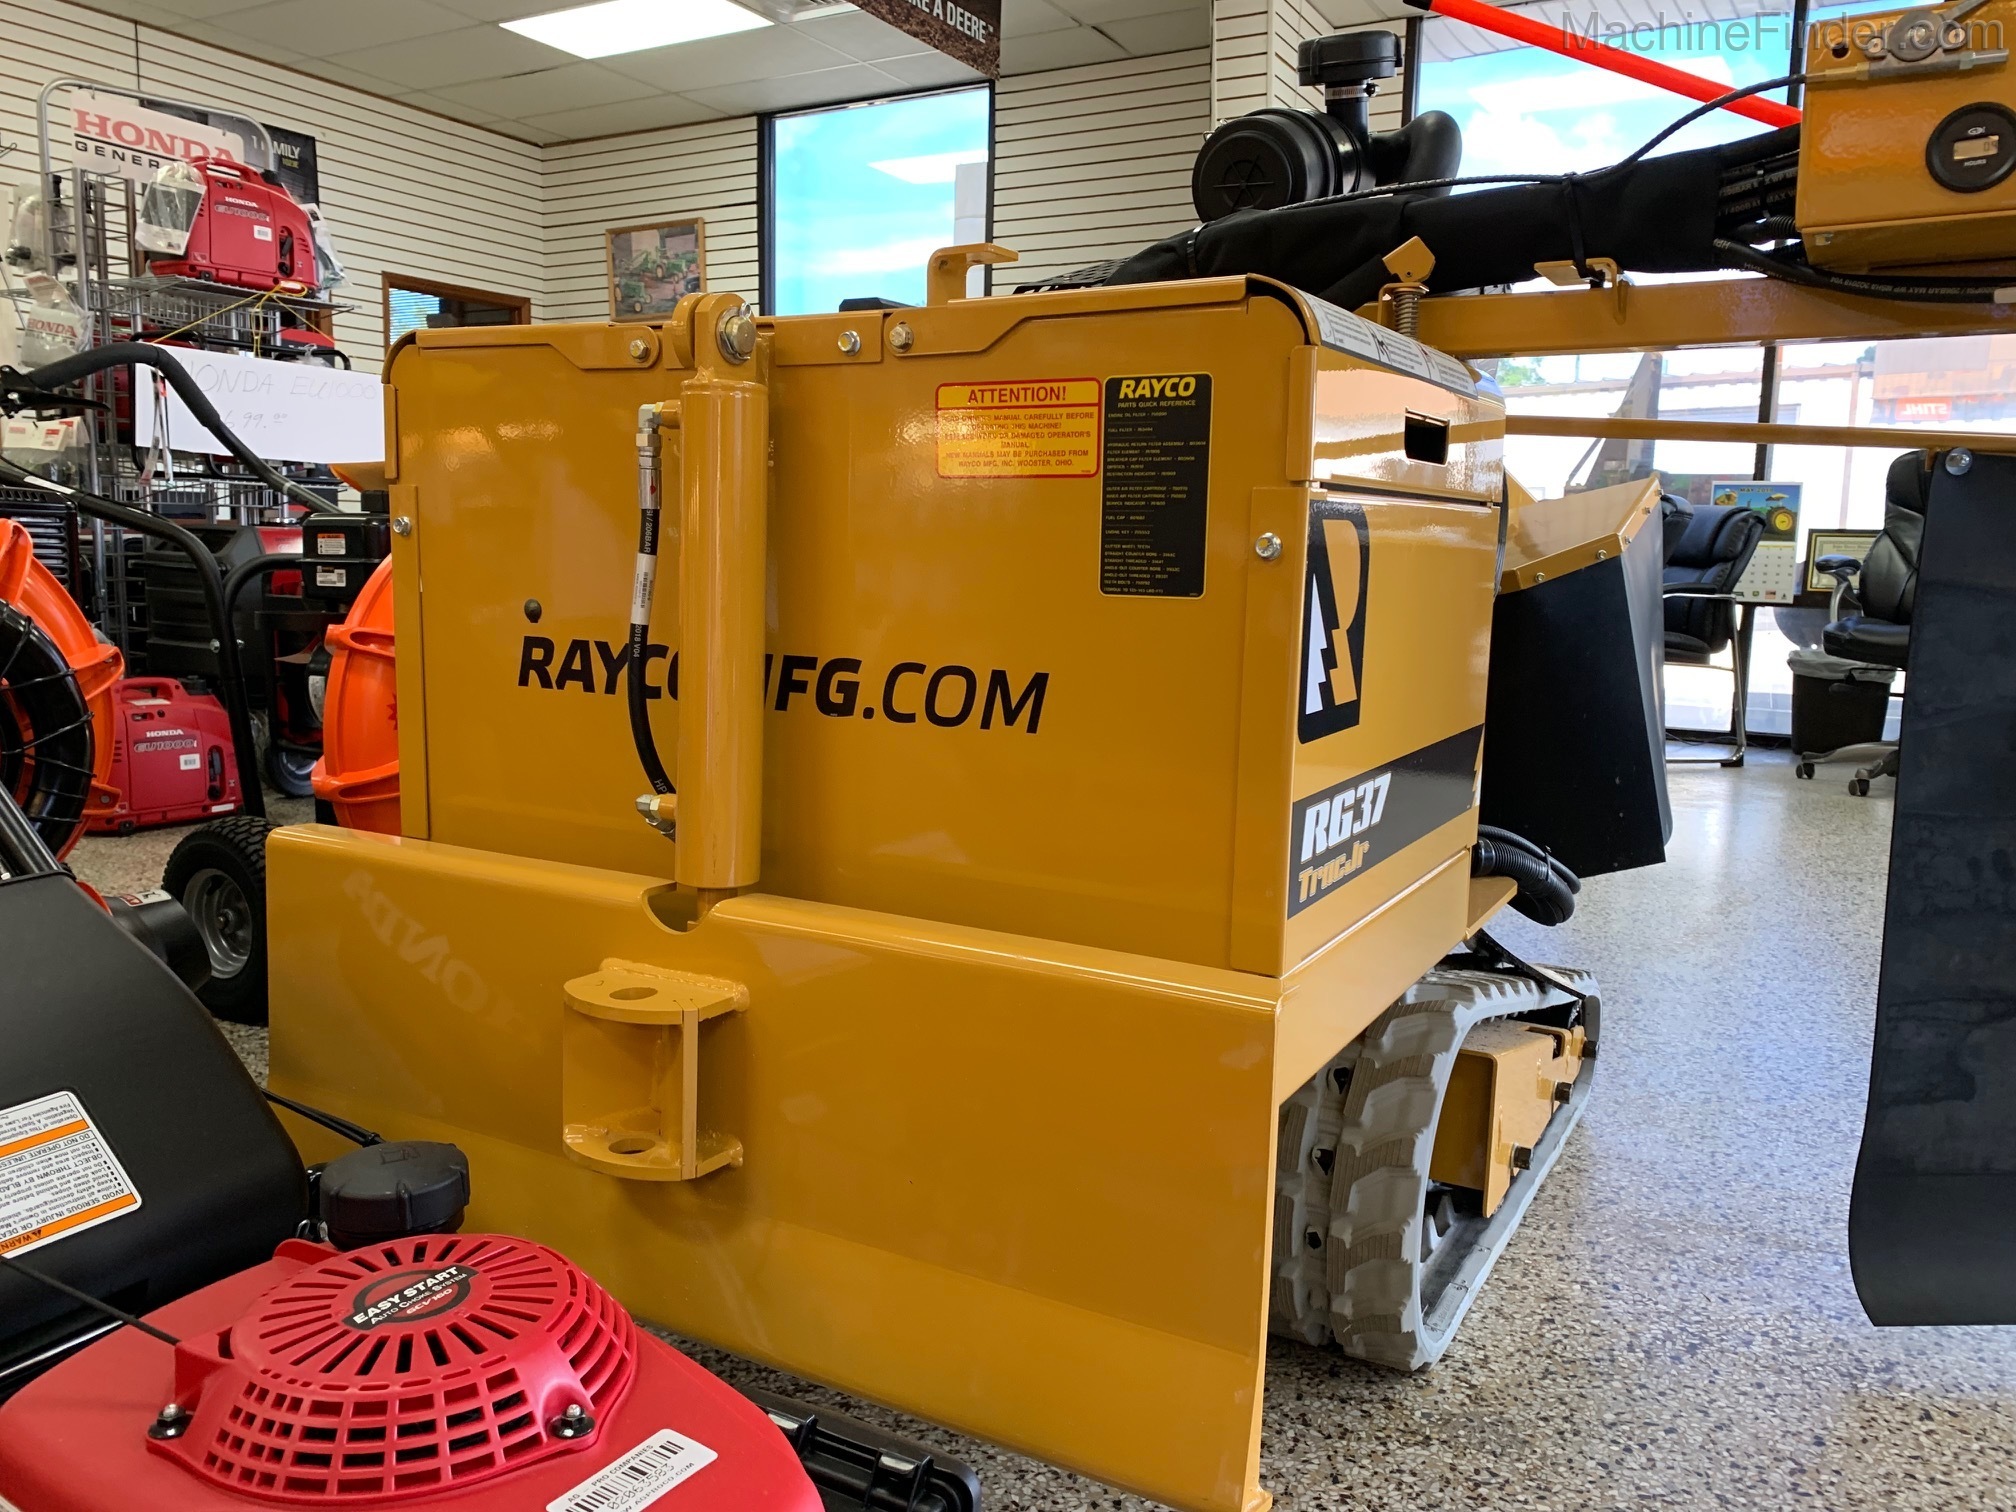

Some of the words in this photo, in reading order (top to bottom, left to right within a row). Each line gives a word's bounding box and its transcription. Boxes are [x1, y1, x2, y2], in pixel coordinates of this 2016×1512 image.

[933, 0, 944, 20] A
[947, 1, 986, 44] DEERE
[72, 108, 235, 163] HONDA
[75, 141, 160, 169] GENER
[225, 196, 259, 208] HONDA
[968, 386, 1066, 404] ATTENTION!
[1118, 376, 1196, 400] RAYCO
[1024, 412, 1064, 420] CAREFULLY
[1066, 412, 1094, 420] BEFORE
[1048, 430, 1091, 438] OPERATOR'S
[643, 522, 652, 554] 206BAR
[146, 729, 184, 738] HONDA
[1300, 771, 1392, 864] RG37
[50, 1113, 78, 1127] Operation
[29, 1125, 42, 1134] This
[63, 1138, 78, 1146] NOT
[28, 1143, 61, 1159] OPERATE
[72, 1149, 94, 1160] Inspect
[74, 1152, 102, 1167] OBJECT
[16, 1168, 40, 1179] remove
[36, 1163, 71, 1181] THROWN
[91, 1167, 106, 1176] Look
[92, 1173, 109, 1182] Avoid
[0, 1181, 21, 1194] BLAD
[24, 1177, 34, 1185] BY
[96, 1178, 113, 1187] Keep
[76, 1184, 95, 1194] safety
[102, 1188, 124, 1201] AVOID
[12, 1193, 34, 1204] before
[66, 1197, 100, 1214] SERIOUS
[36, 1211, 64, 1225] INJURY
[20, 1222, 33, 1231] OR
[0, 1234, 32, 1250] WARN
[353, 1294, 401, 1324] EASY
[404, 1266, 458, 1298] START
[370, 1308, 399, 1324] AUTO
[398, 1290, 432, 1308] CHOKE
[432, 1273, 468, 1291] SYSTEM
[406, 1288, 452, 1314] GCV160
[568, 1493, 581, 1503] AG
[592, 1474, 610, 1488] PRO
[610, 1444, 654, 1474] COMPANIES
[607, 1462, 675, 1510] 02063583
